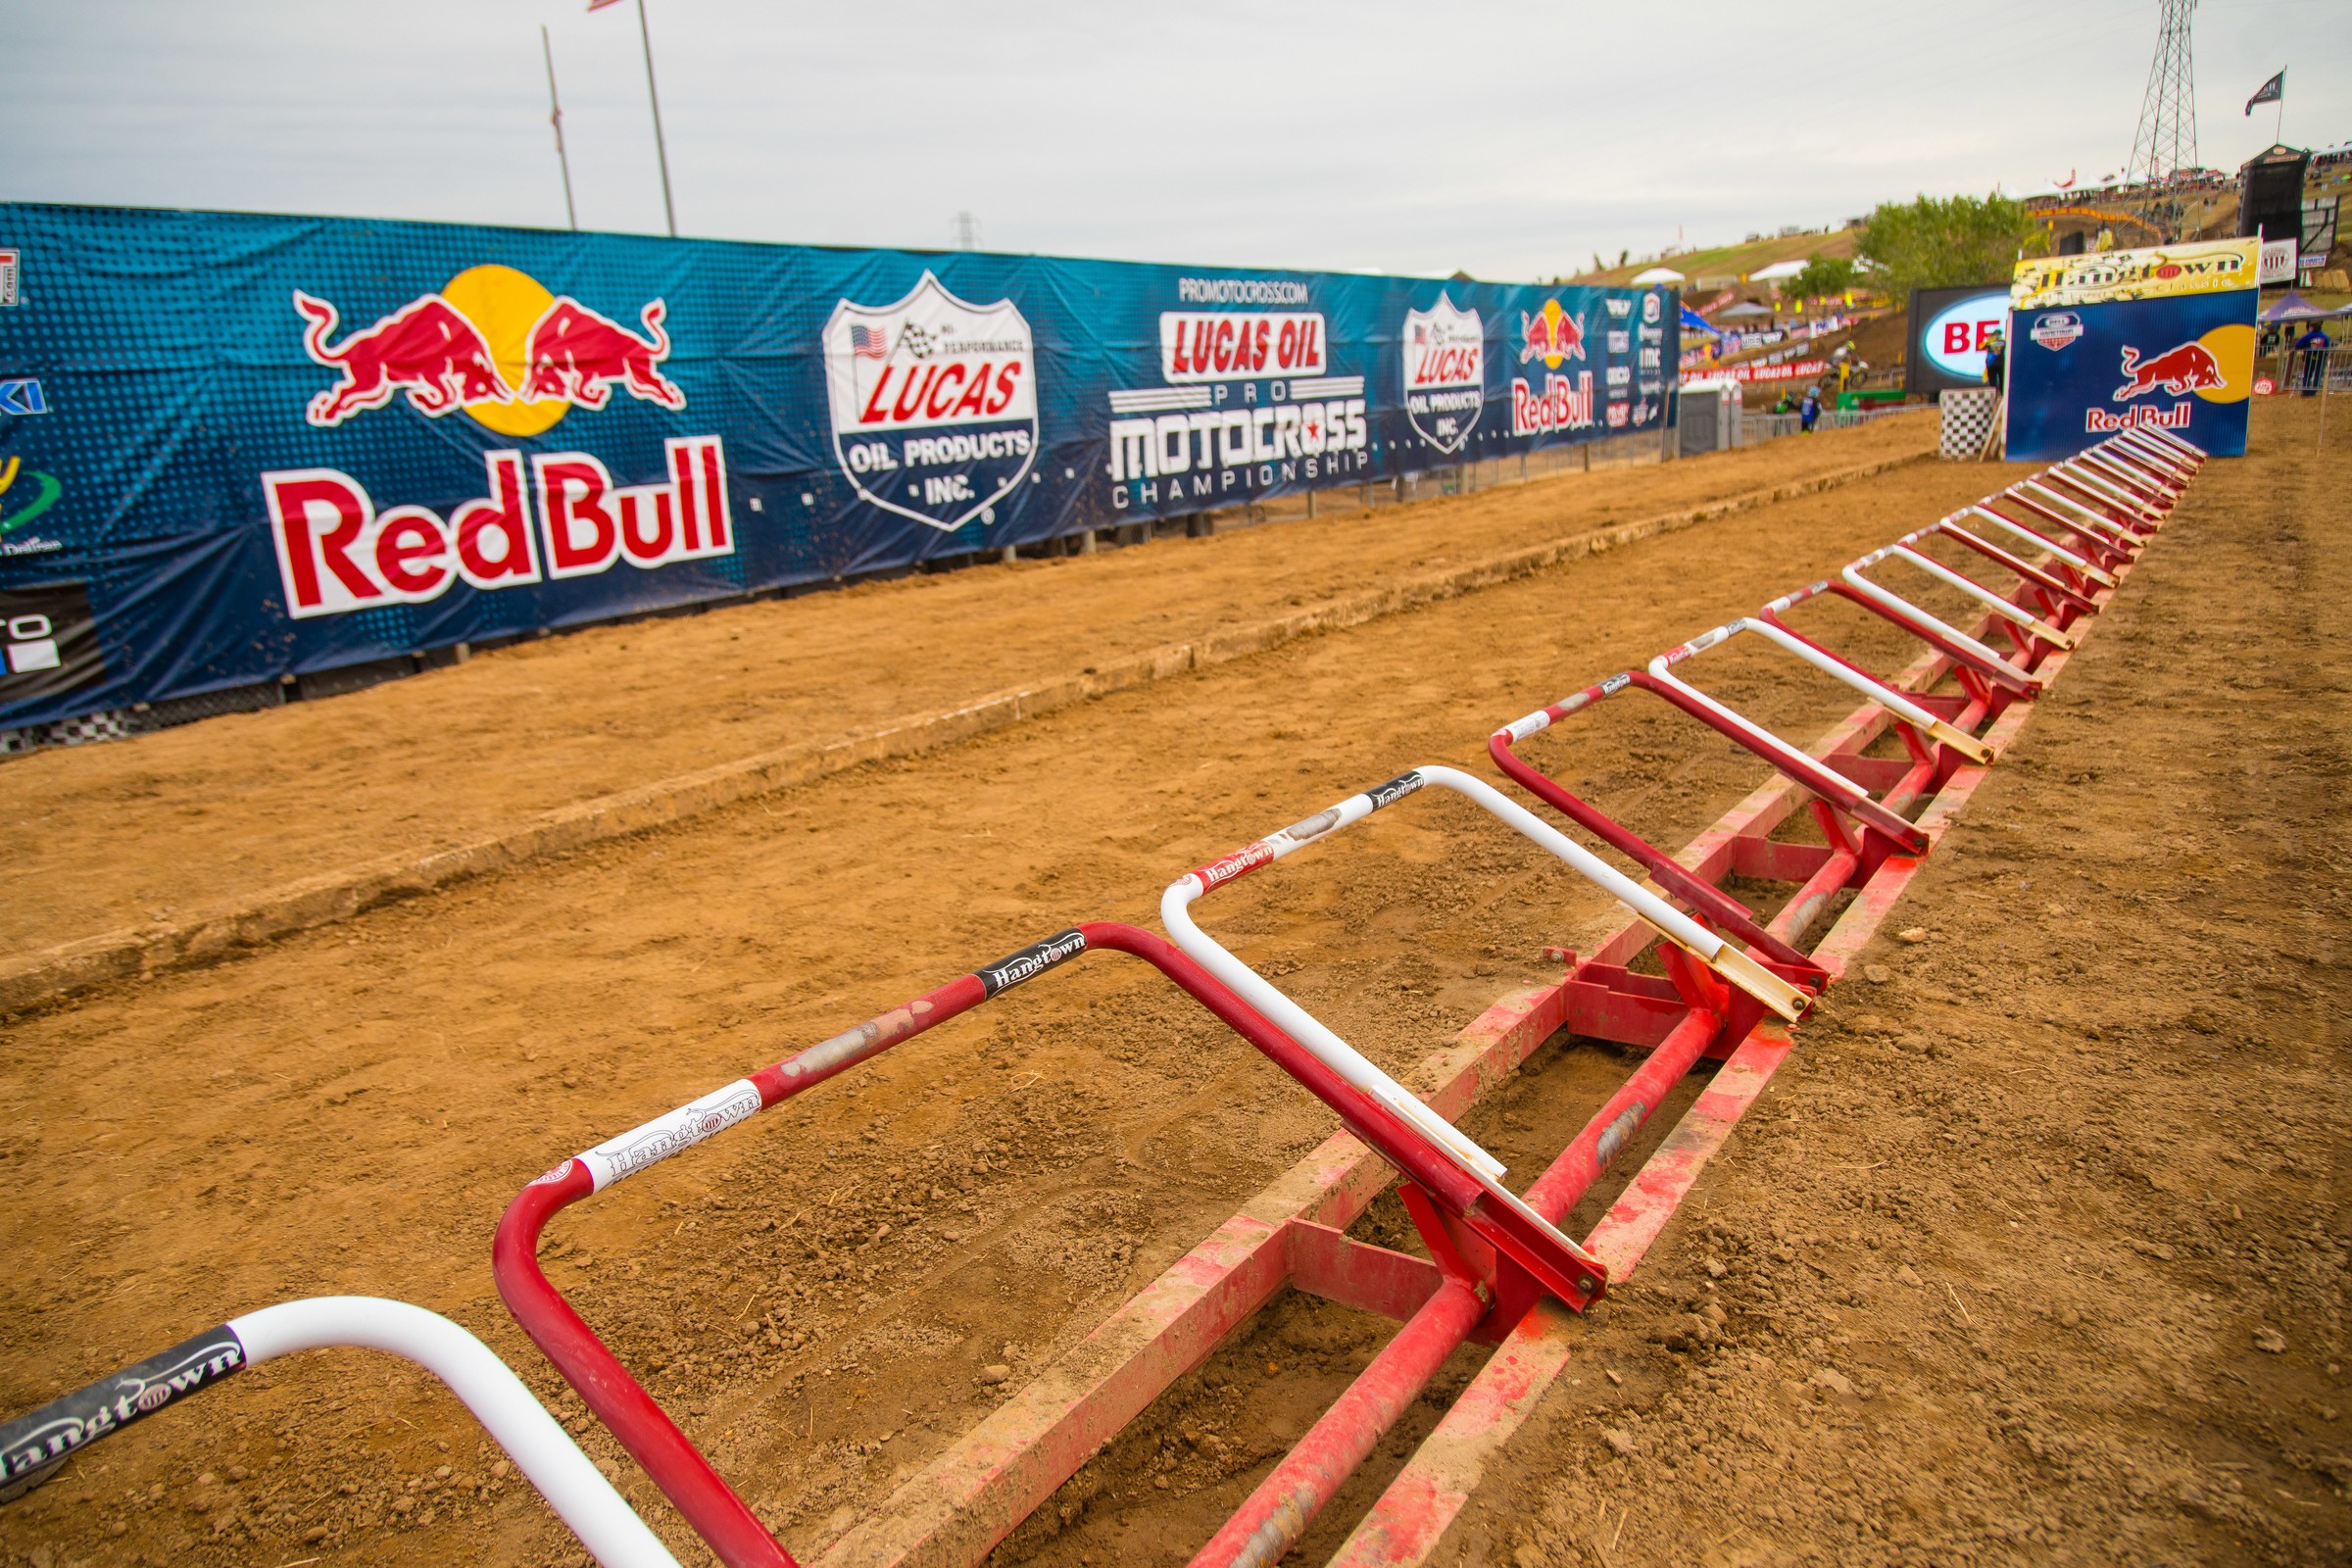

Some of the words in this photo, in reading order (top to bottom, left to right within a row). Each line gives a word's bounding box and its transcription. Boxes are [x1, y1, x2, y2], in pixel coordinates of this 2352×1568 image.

[1173, 318, 1270, 373] LUCAS
[1278, 318, 1319, 368] OIL
[1944, 319, 2009, 355] BE
[1415, 347, 1478, 384] LUCAS
[859, 361, 1021, 423] LUCAS
[1214, 381, 1287, 405] PRO
[1410, 394, 1429, 415] OIL
[1430, 390, 1481, 411] PRODUCTS
[1512, 373, 1555, 436] Red
[1554, 369, 1592, 430] Bull
[2085, 404, 2139, 433] Red
[2139, 401, 2191, 429] Bull
[850, 443, 898, 473] OIL
[904, 429, 1030, 466] PRODUCTS
[1109, 399, 1367, 481] MOTOCROSS
[924, 474, 975, 505] INC.
[1112, 452, 1368, 509] CHAMPIONSHIP
[263, 450, 542, 618] Red
[532, 435, 734, 579] Bull
[1376, 775, 1424, 808] Hangtown
[1204, 844, 1273, 882] Hangtown
[992, 933, 1086, 988] Hangtown
[606, 1090, 761, 1177] Hangtown
